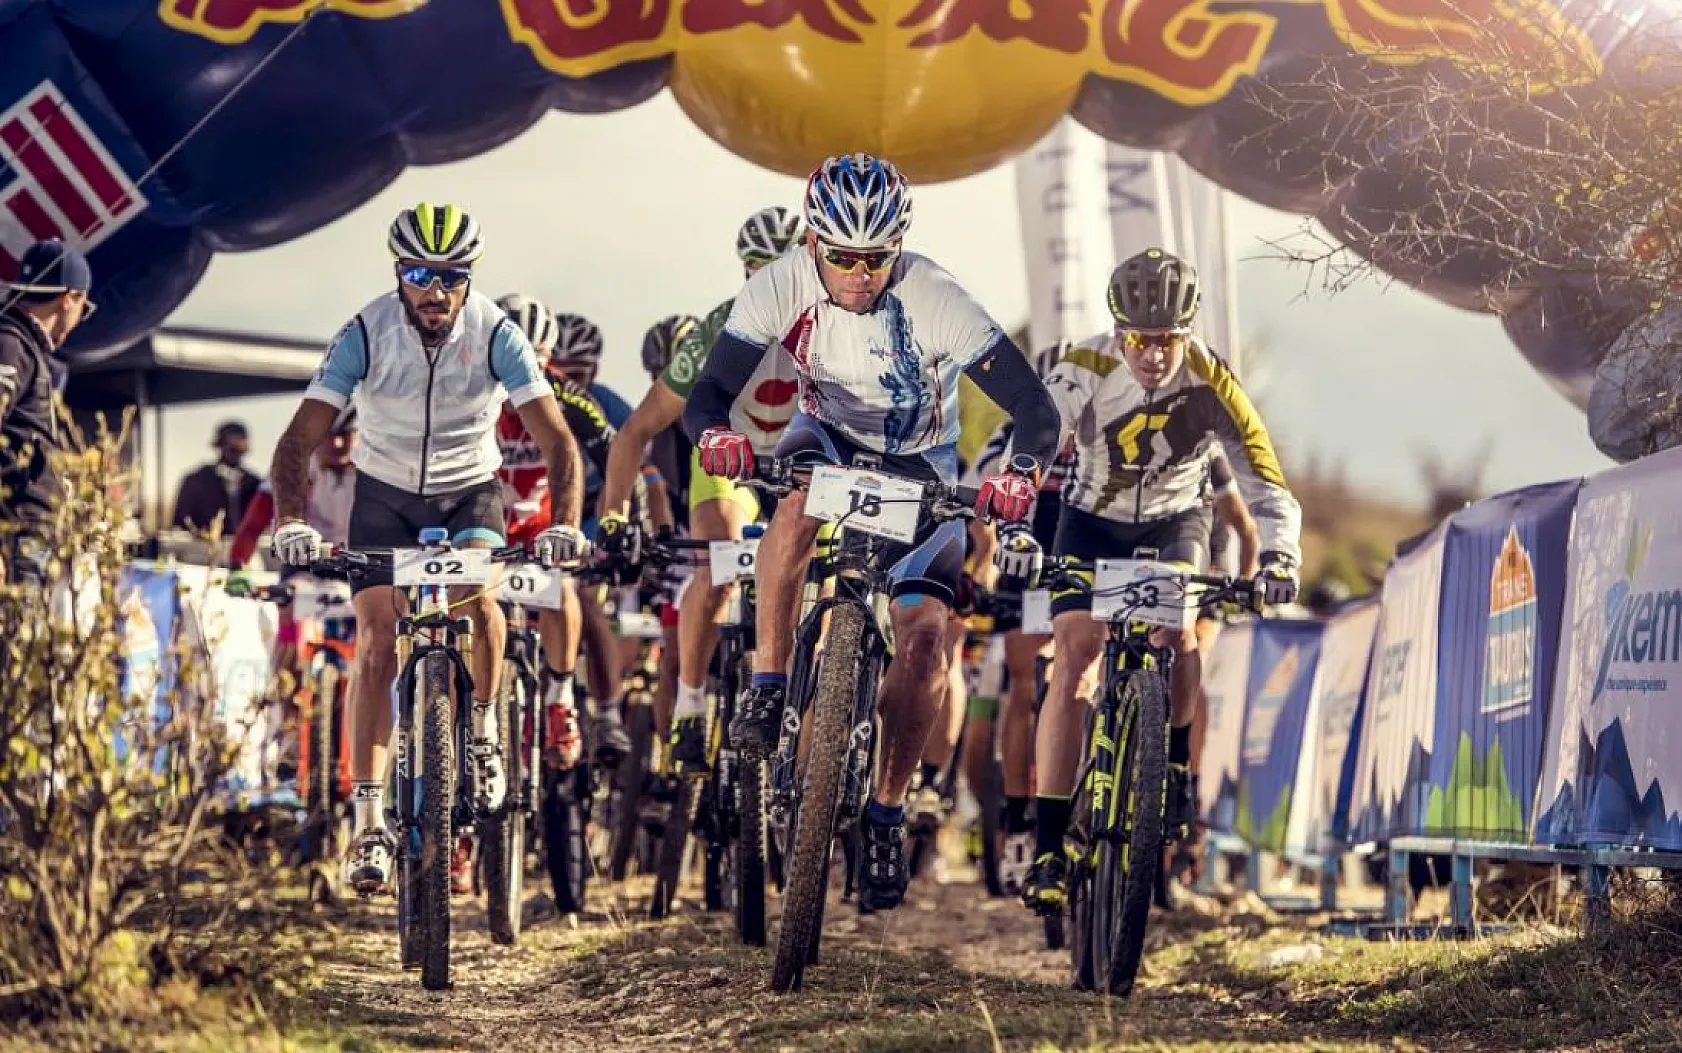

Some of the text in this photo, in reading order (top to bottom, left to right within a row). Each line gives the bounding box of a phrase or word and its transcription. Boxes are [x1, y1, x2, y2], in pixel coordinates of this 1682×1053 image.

[848, 490, 881, 517] 15
[424, 561, 463, 574] 02
[737, 552, 754, 567] 0
[510, 575, 535, 592] 01
